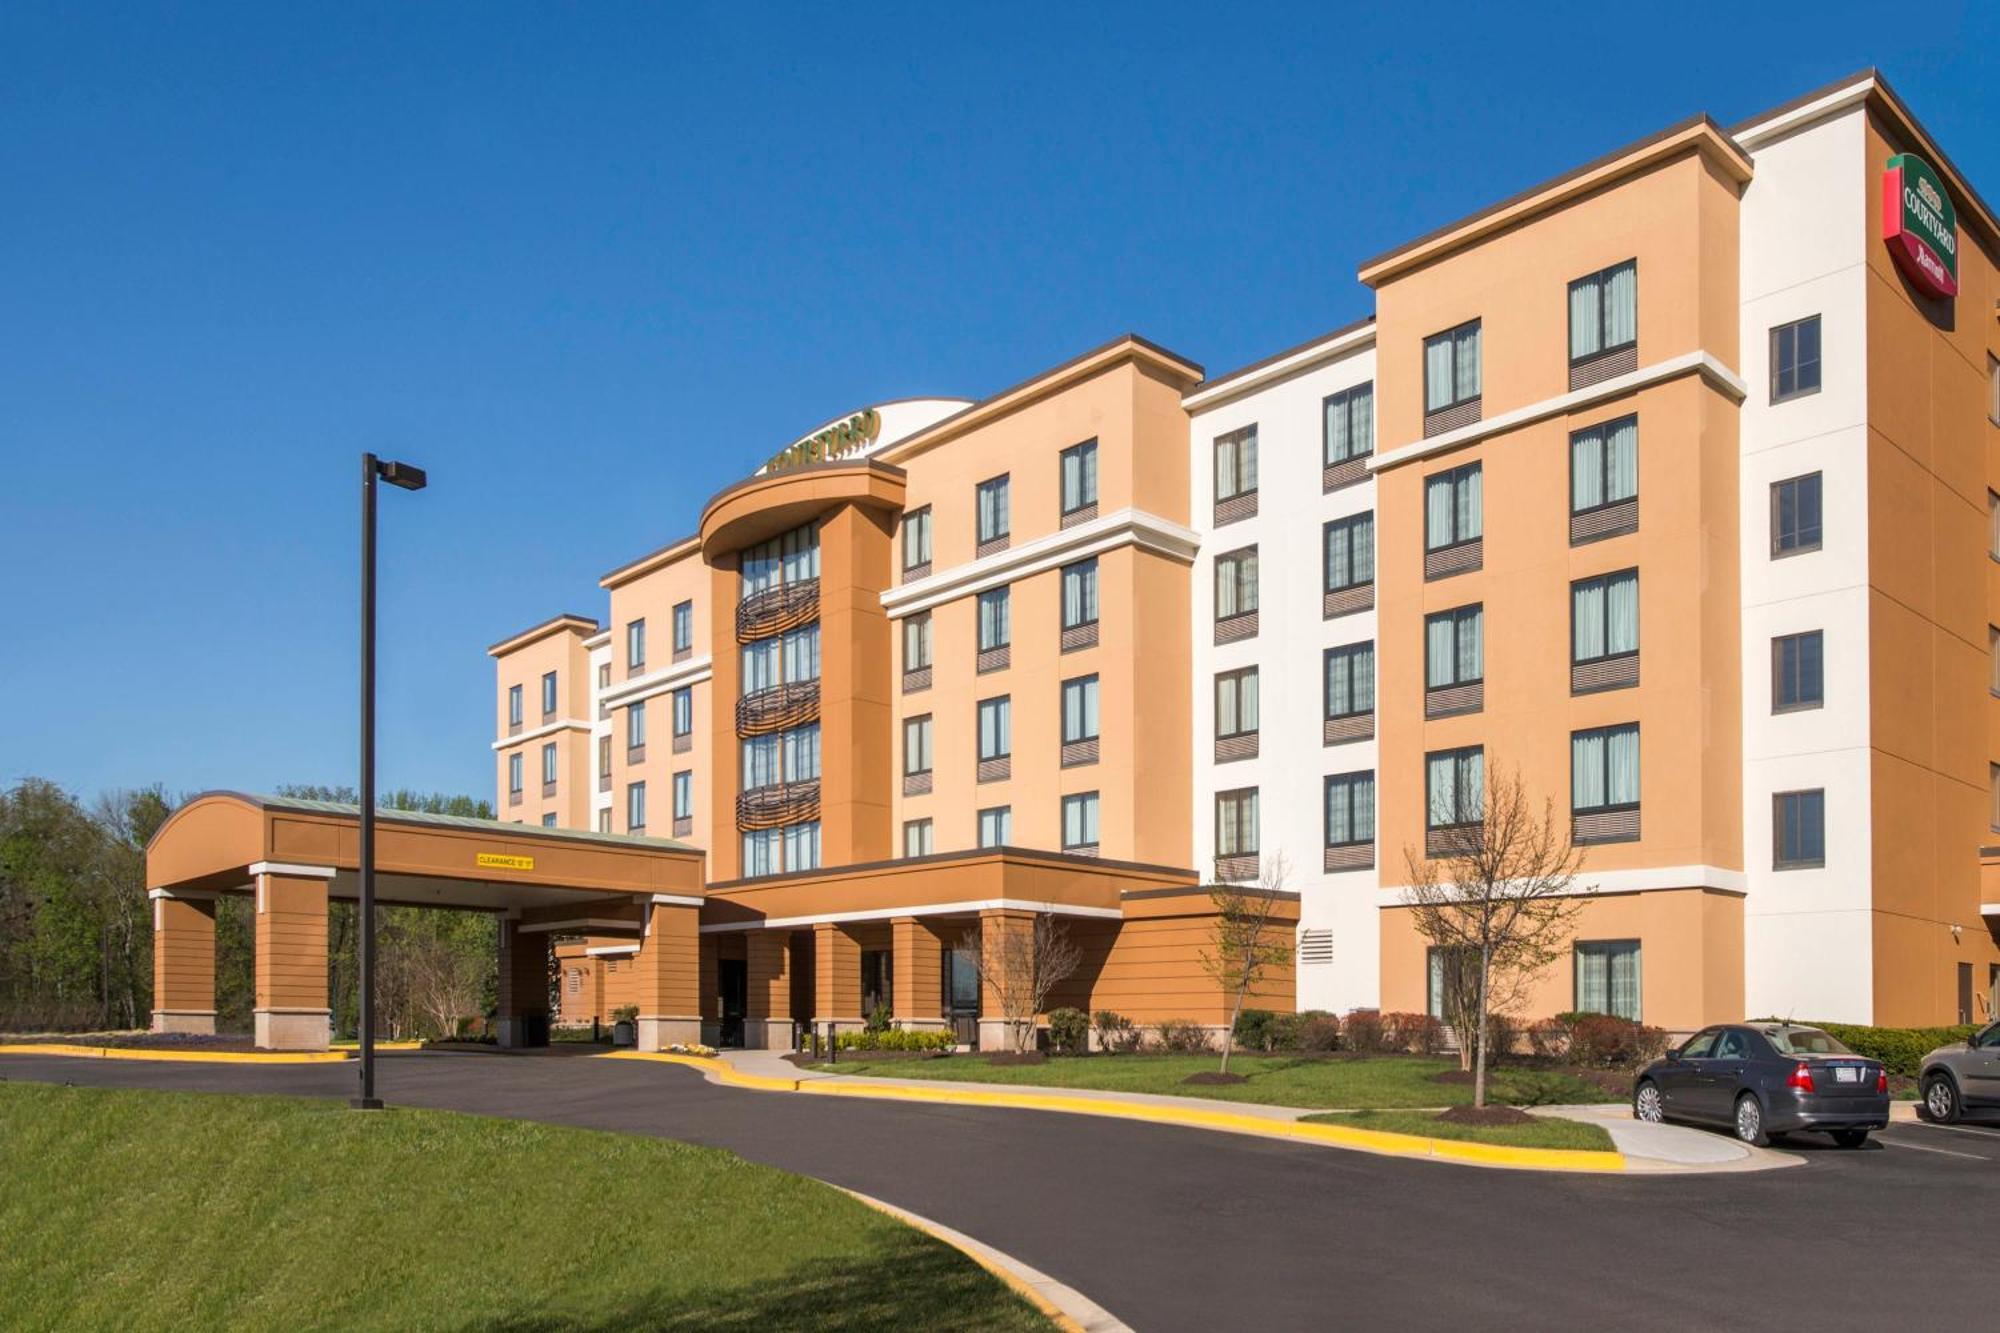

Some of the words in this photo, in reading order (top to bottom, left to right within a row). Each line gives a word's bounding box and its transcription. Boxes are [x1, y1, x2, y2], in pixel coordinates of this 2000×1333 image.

[1904, 187, 1955, 255] COURTYARD
[1916, 244, 1944, 284] Marriott
[479, 856, 516, 866] CLEARANCE
